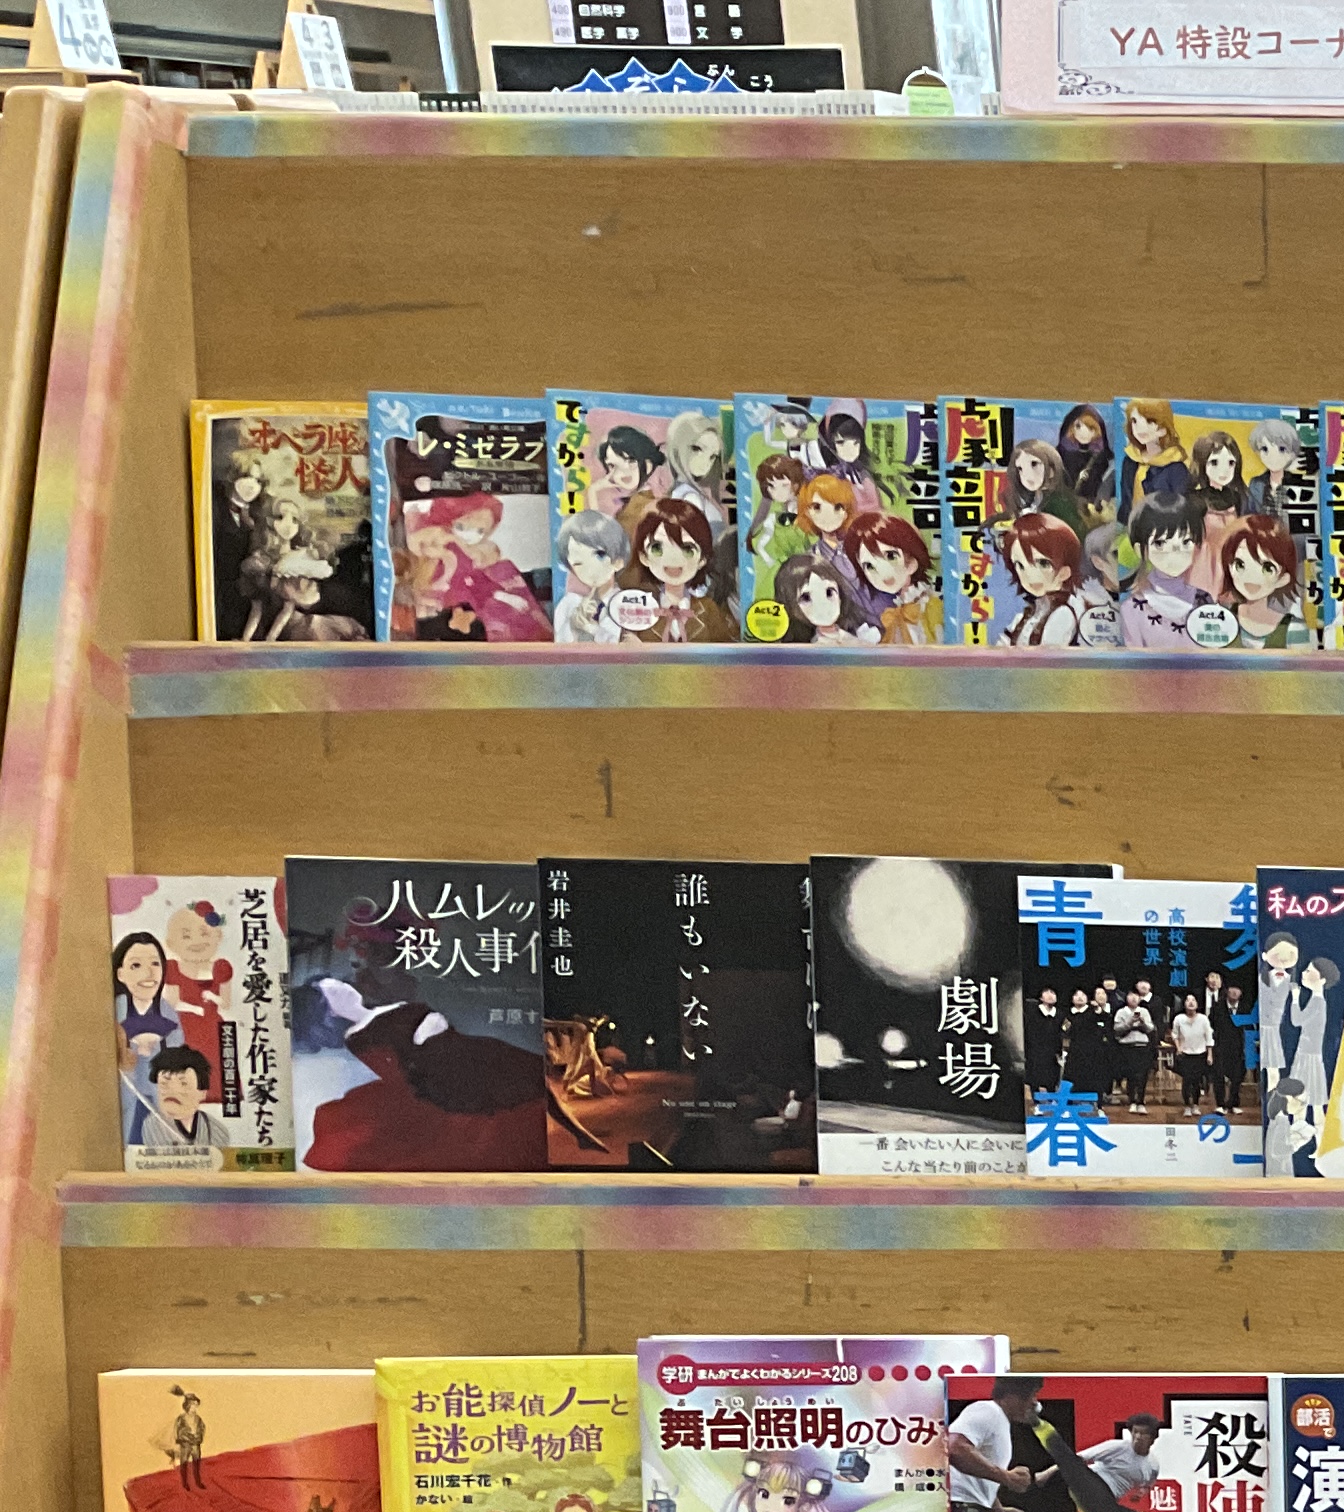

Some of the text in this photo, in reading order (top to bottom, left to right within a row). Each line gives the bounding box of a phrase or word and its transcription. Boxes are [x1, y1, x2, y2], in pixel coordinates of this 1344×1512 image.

[546, 869, 575, 977] 岩井圭也
[1168, 907, 1188, 987] 高校演劇
[673, 872, 714, 1061] 誰もいない
[238, 888, 280, 1147] 芝居を愛した作家たち
[937, 976, 1002, 1100] 劇場
[410, 1382, 631, 1418] お能探偵ノーと
[661, 1365, 694, 1384] 学研
[411, 1423, 605, 1466] 謎の博物館
[658, 1408, 947, 1451] 舞台照明のひみ
